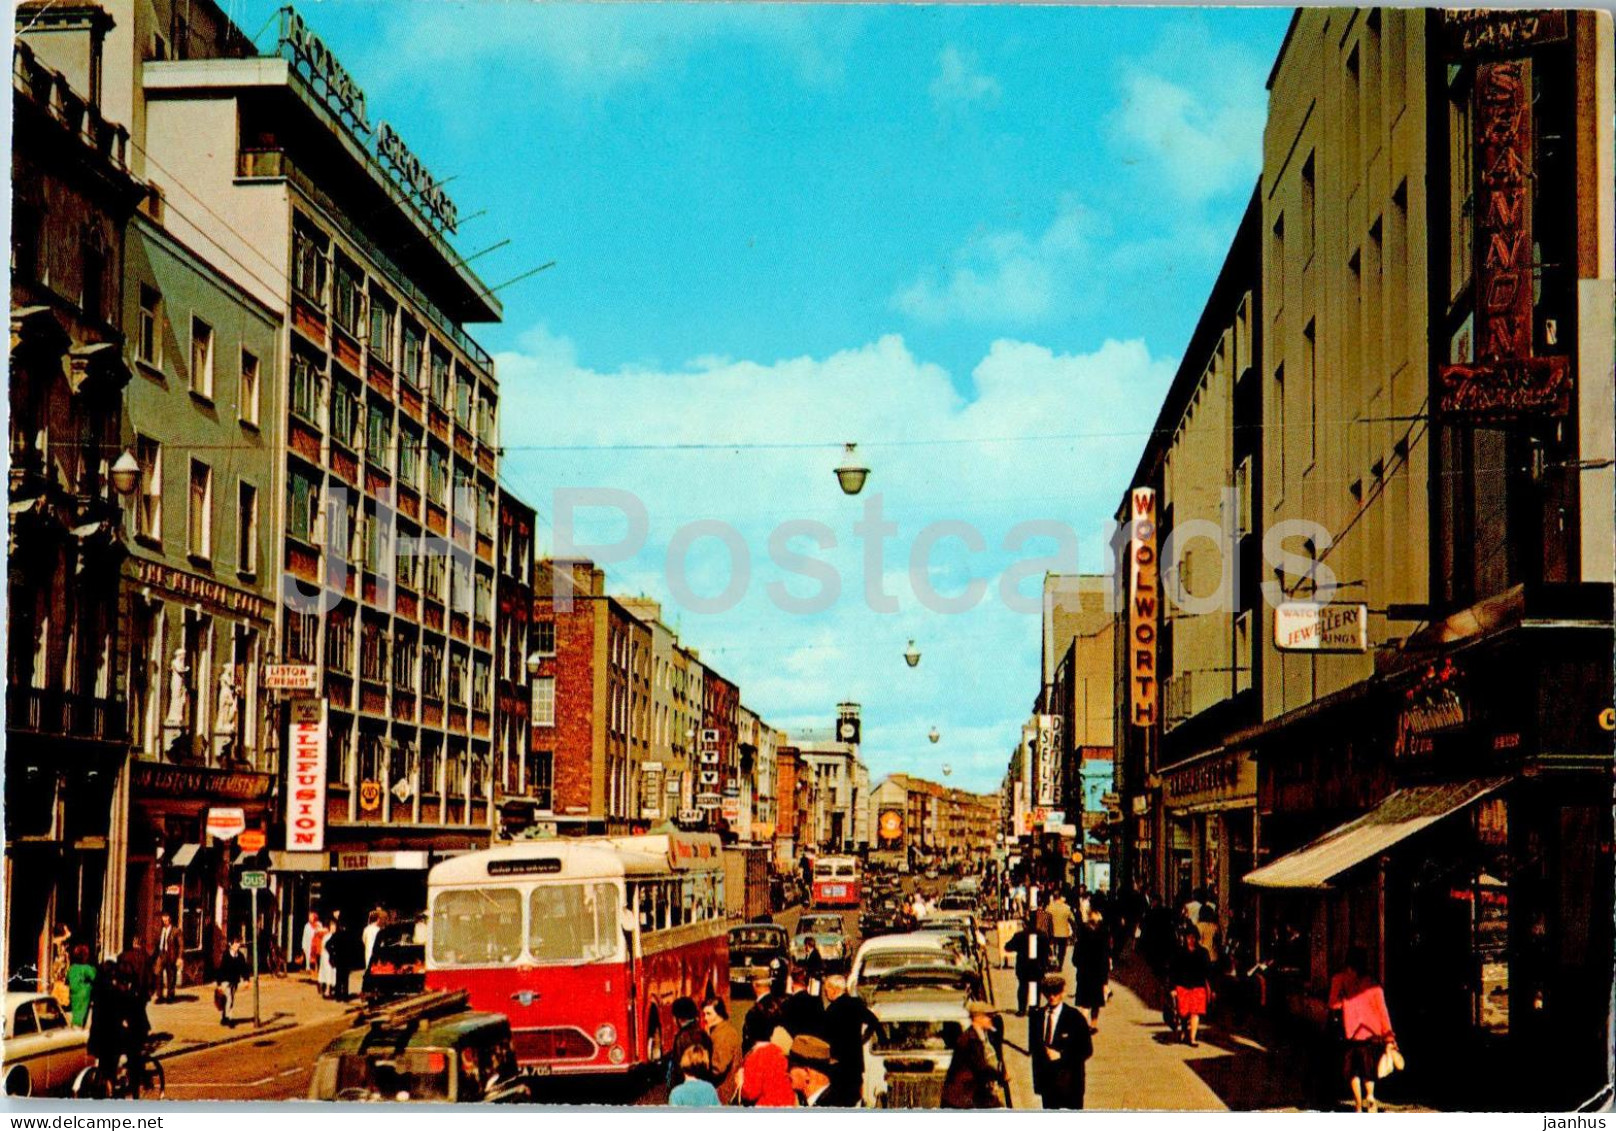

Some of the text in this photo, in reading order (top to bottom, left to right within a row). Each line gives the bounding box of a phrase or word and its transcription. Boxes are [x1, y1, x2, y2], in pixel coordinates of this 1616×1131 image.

[1134, 492, 1153, 722] WOOLWORTH
[1282, 608, 1336, 619] WATCHES
[1287, 608, 1359, 646] JEWELLERY
[1321, 633, 1357, 645] RINGS
[270, 665, 307, 676] LISTON
[267, 677, 310, 688] CHEMIST
[1041, 716, 1062, 804] SELF DRIVE
